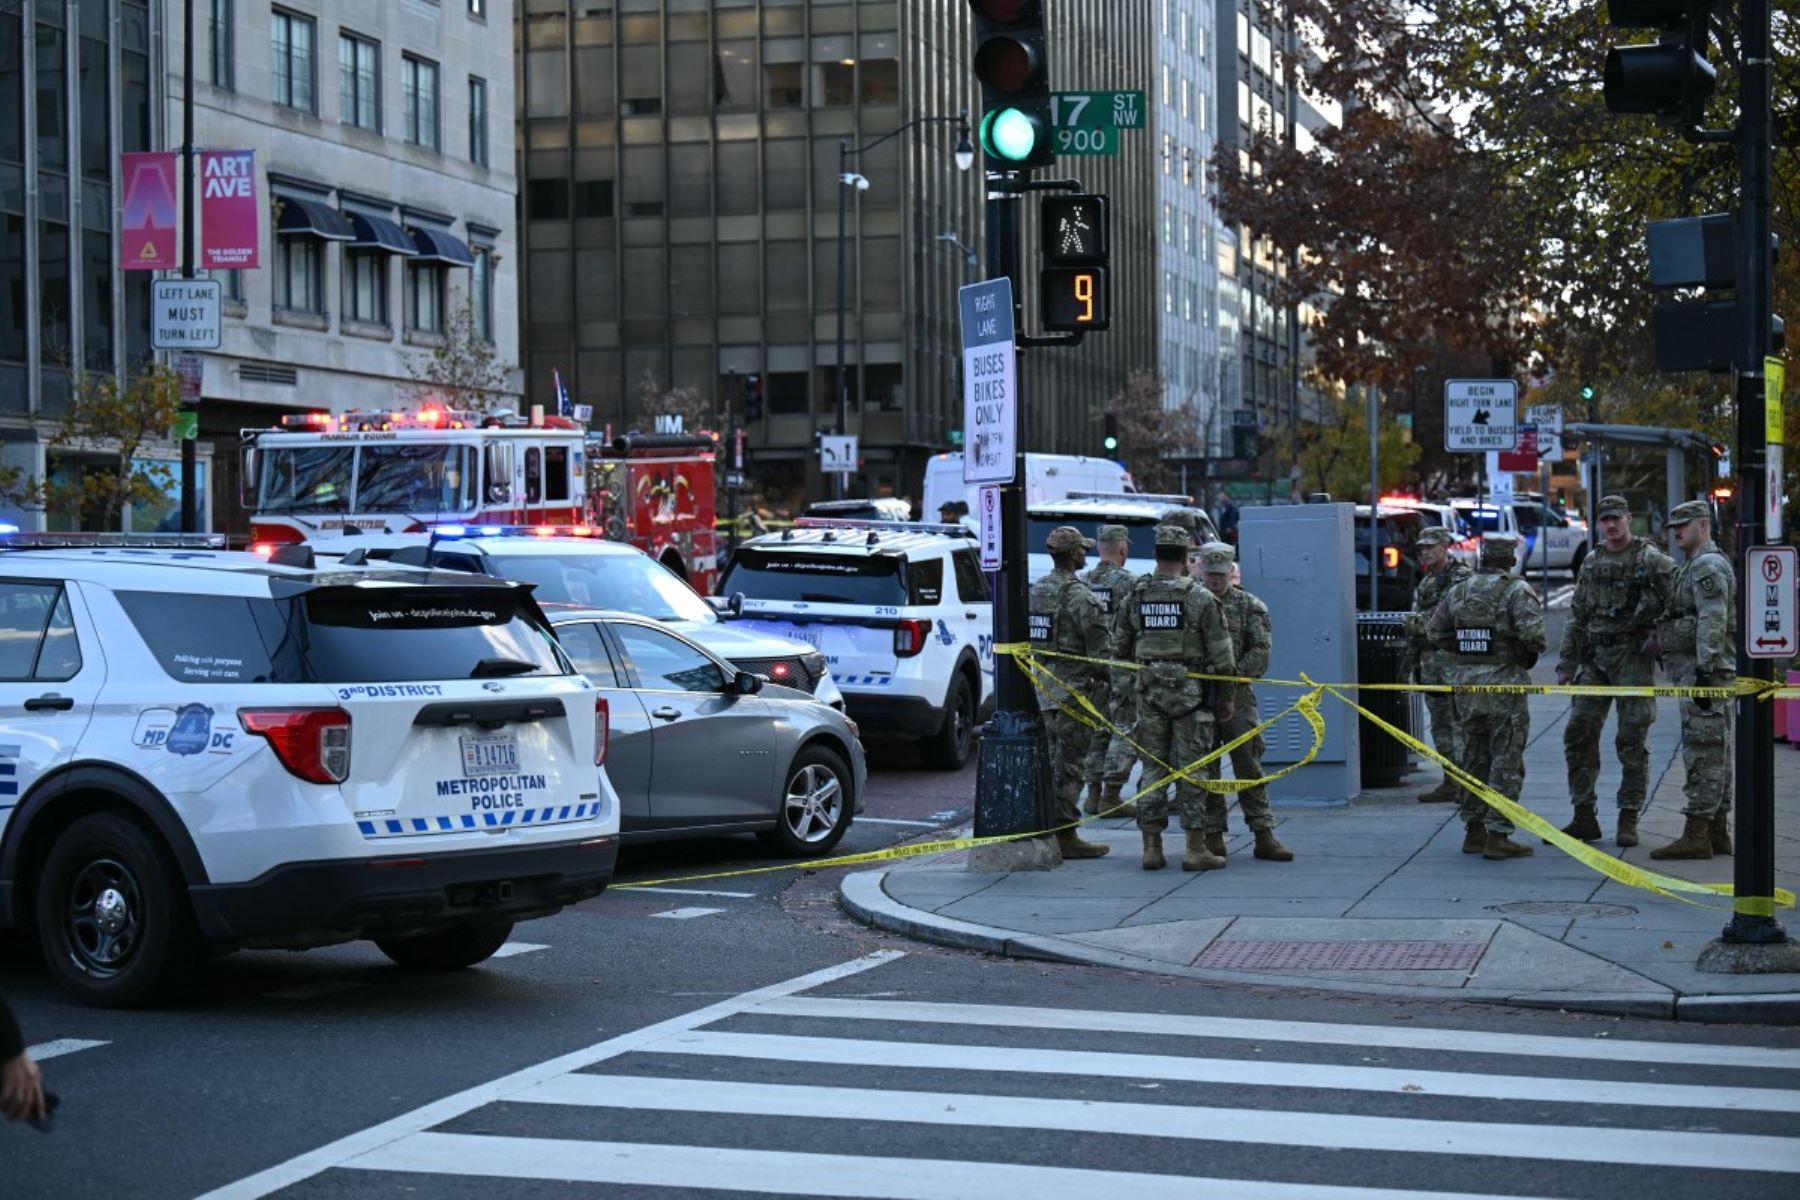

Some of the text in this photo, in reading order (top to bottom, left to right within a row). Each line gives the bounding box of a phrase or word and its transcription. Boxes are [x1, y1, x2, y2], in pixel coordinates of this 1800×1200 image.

[1113, 94, 1137, 110] ST
[1113, 109, 1138, 126] NW
[1058, 129, 1105, 151] 900
[204, 156, 251, 178] ART
[204, 178, 252, 198] AVE
[208, 248, 252, 256] THE GOLDEN
[212, 255, 248, 263] TRIANGLE
[159, 288, 214, 300] LEFT LANE
[1075, 274, 1093, 321] 9
[974, 293, 996, 312] RIGHT
[167, 307, 205, 321] MUST
[158, 328, 215, 341] TURN LEFT
[977, 318, 996, 337] LANE
[973, 352, 1004, 377] BUSES
[974, 379, 1005, 403] BIKES
[1468, 386, 1495, 397] BEGIN
[1449, 399, 1513, 408] RIGHT TURN LANE
[976, 403, 1004, 426] ONLY
[1449, 426, 1472, 435] YIELD
[1475, 426, 1486, 435] TO
[1460, 436, 1476, 445] AND
[1140, 603, 1182, 616] NATIONAL
[1145, 615, 1178, 628] GUARD
[1457, 629, 1492, 640] NATIONAL
[1460, 640, 1487, 652] GUARD
[366, 684, 442, 697] DISTRICT
[142, 729, 166, 745] MP
[210, 733, 235, 749] DC
[436, 775, 546, 796] METROPOLITAN
[471, 793, 524, 811] POLICE
